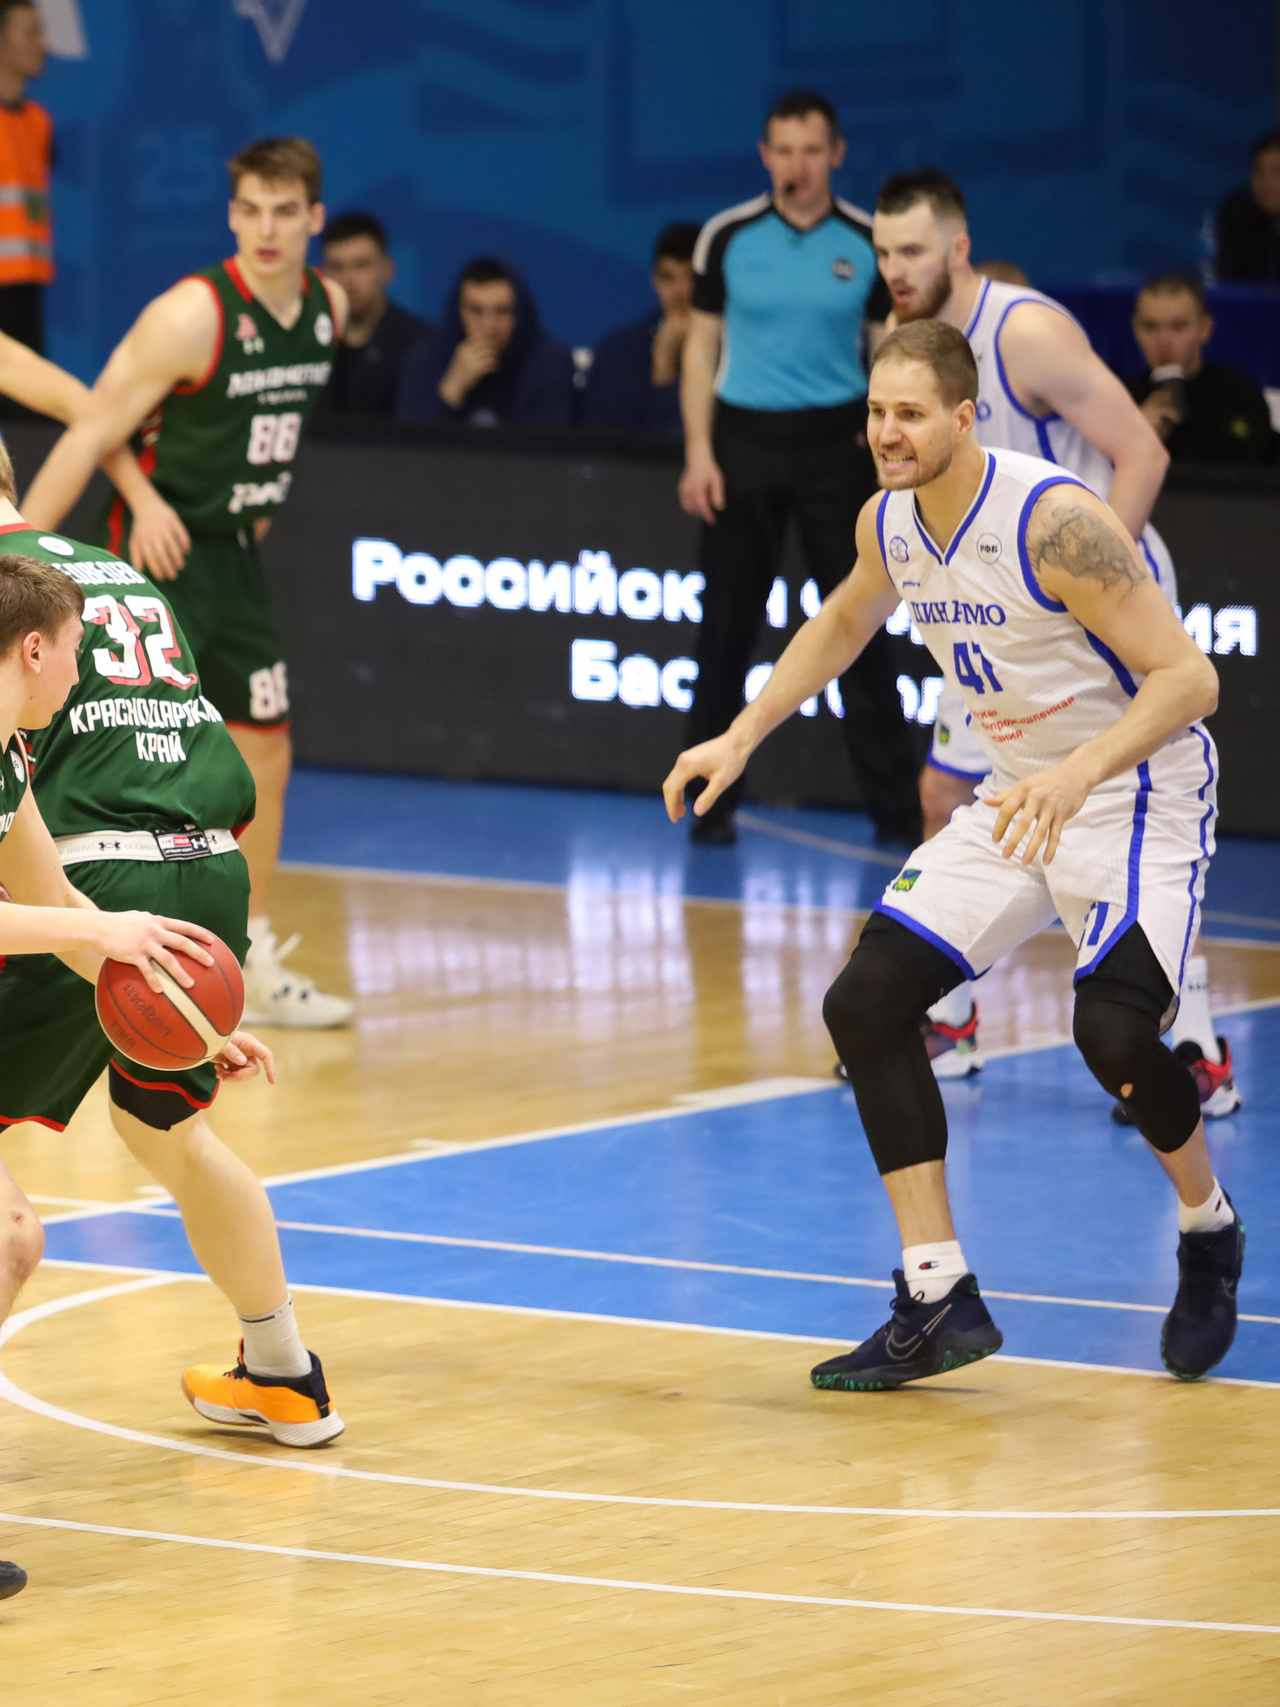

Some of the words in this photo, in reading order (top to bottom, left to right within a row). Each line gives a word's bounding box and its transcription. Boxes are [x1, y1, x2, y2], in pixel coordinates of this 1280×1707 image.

[246, 412, 302, 467] 88
[81, 594, 198, 691] 32
[953, 641, 1004, 694] 41
[134, 731, 187, 763] КРАЙ
